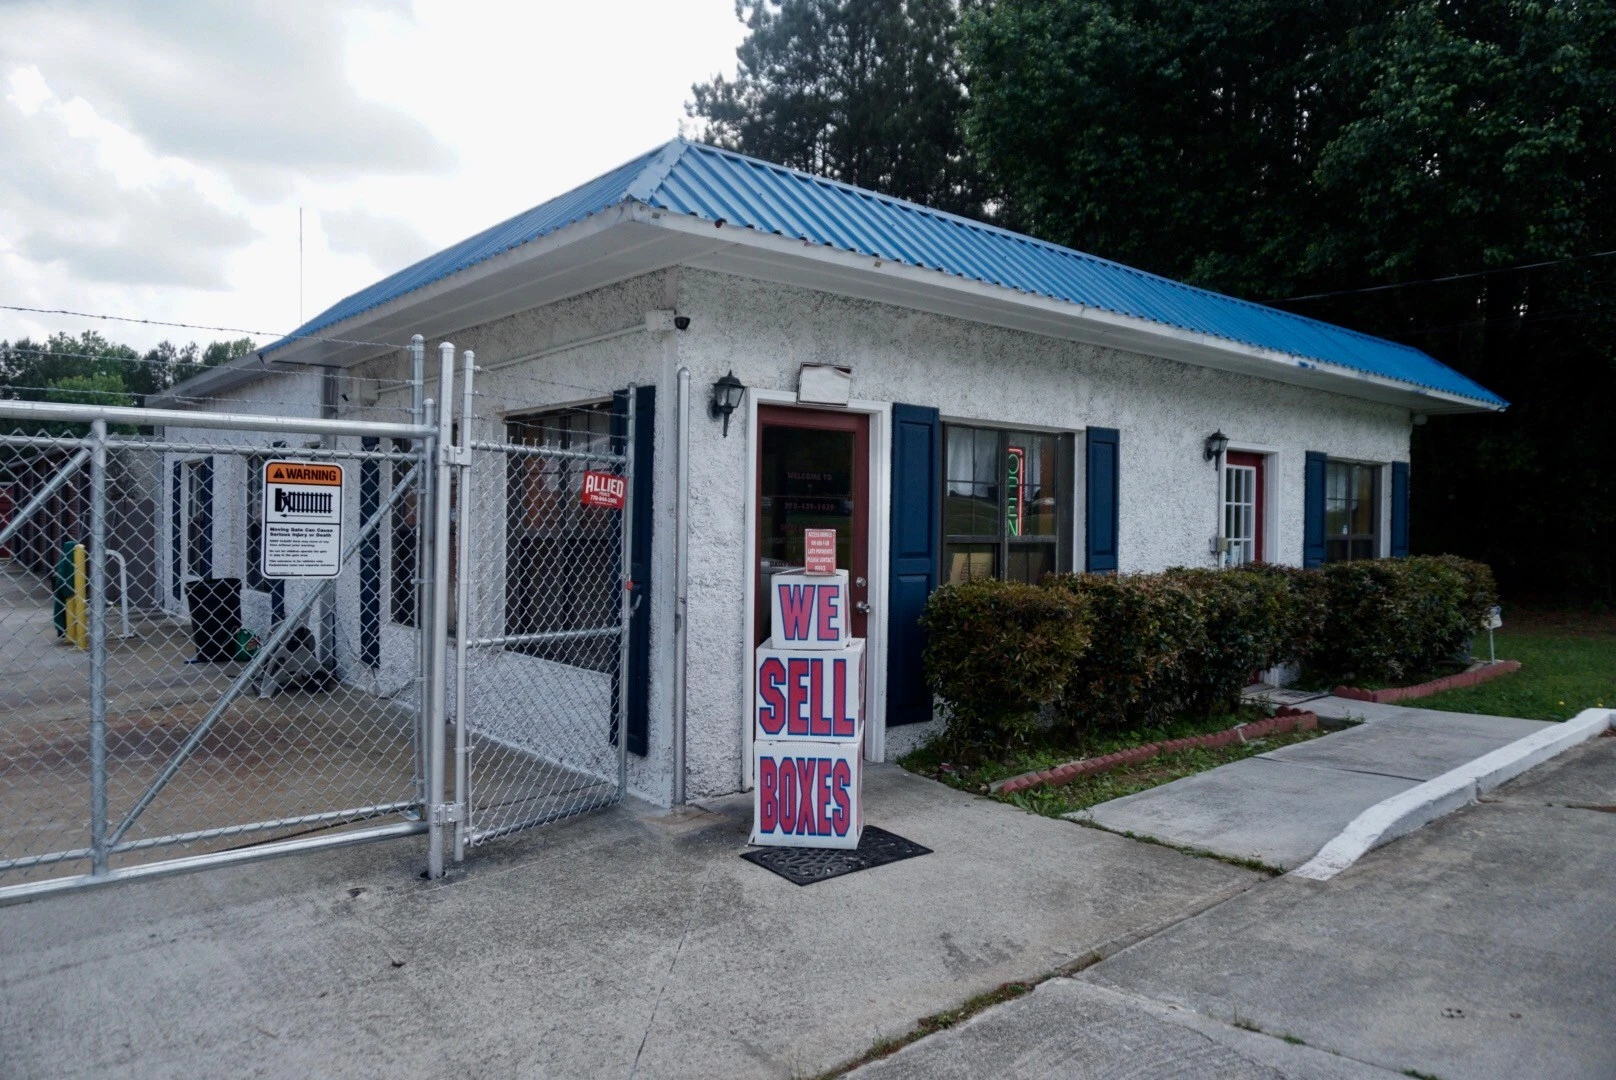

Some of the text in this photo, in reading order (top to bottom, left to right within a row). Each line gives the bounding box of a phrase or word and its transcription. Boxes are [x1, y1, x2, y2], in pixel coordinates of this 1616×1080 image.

[286, 468, 336, 481] WARNING
[586, 475, 624, 498] ALLIED
[787, 472, 832, 480] WELCOME TO
[1008, 453, 1020, 537] OPEN
[778, 584, 839, 641] WE
[759, 657, 855, 737] SELL
[760, 756, 850, 838] BOXES
